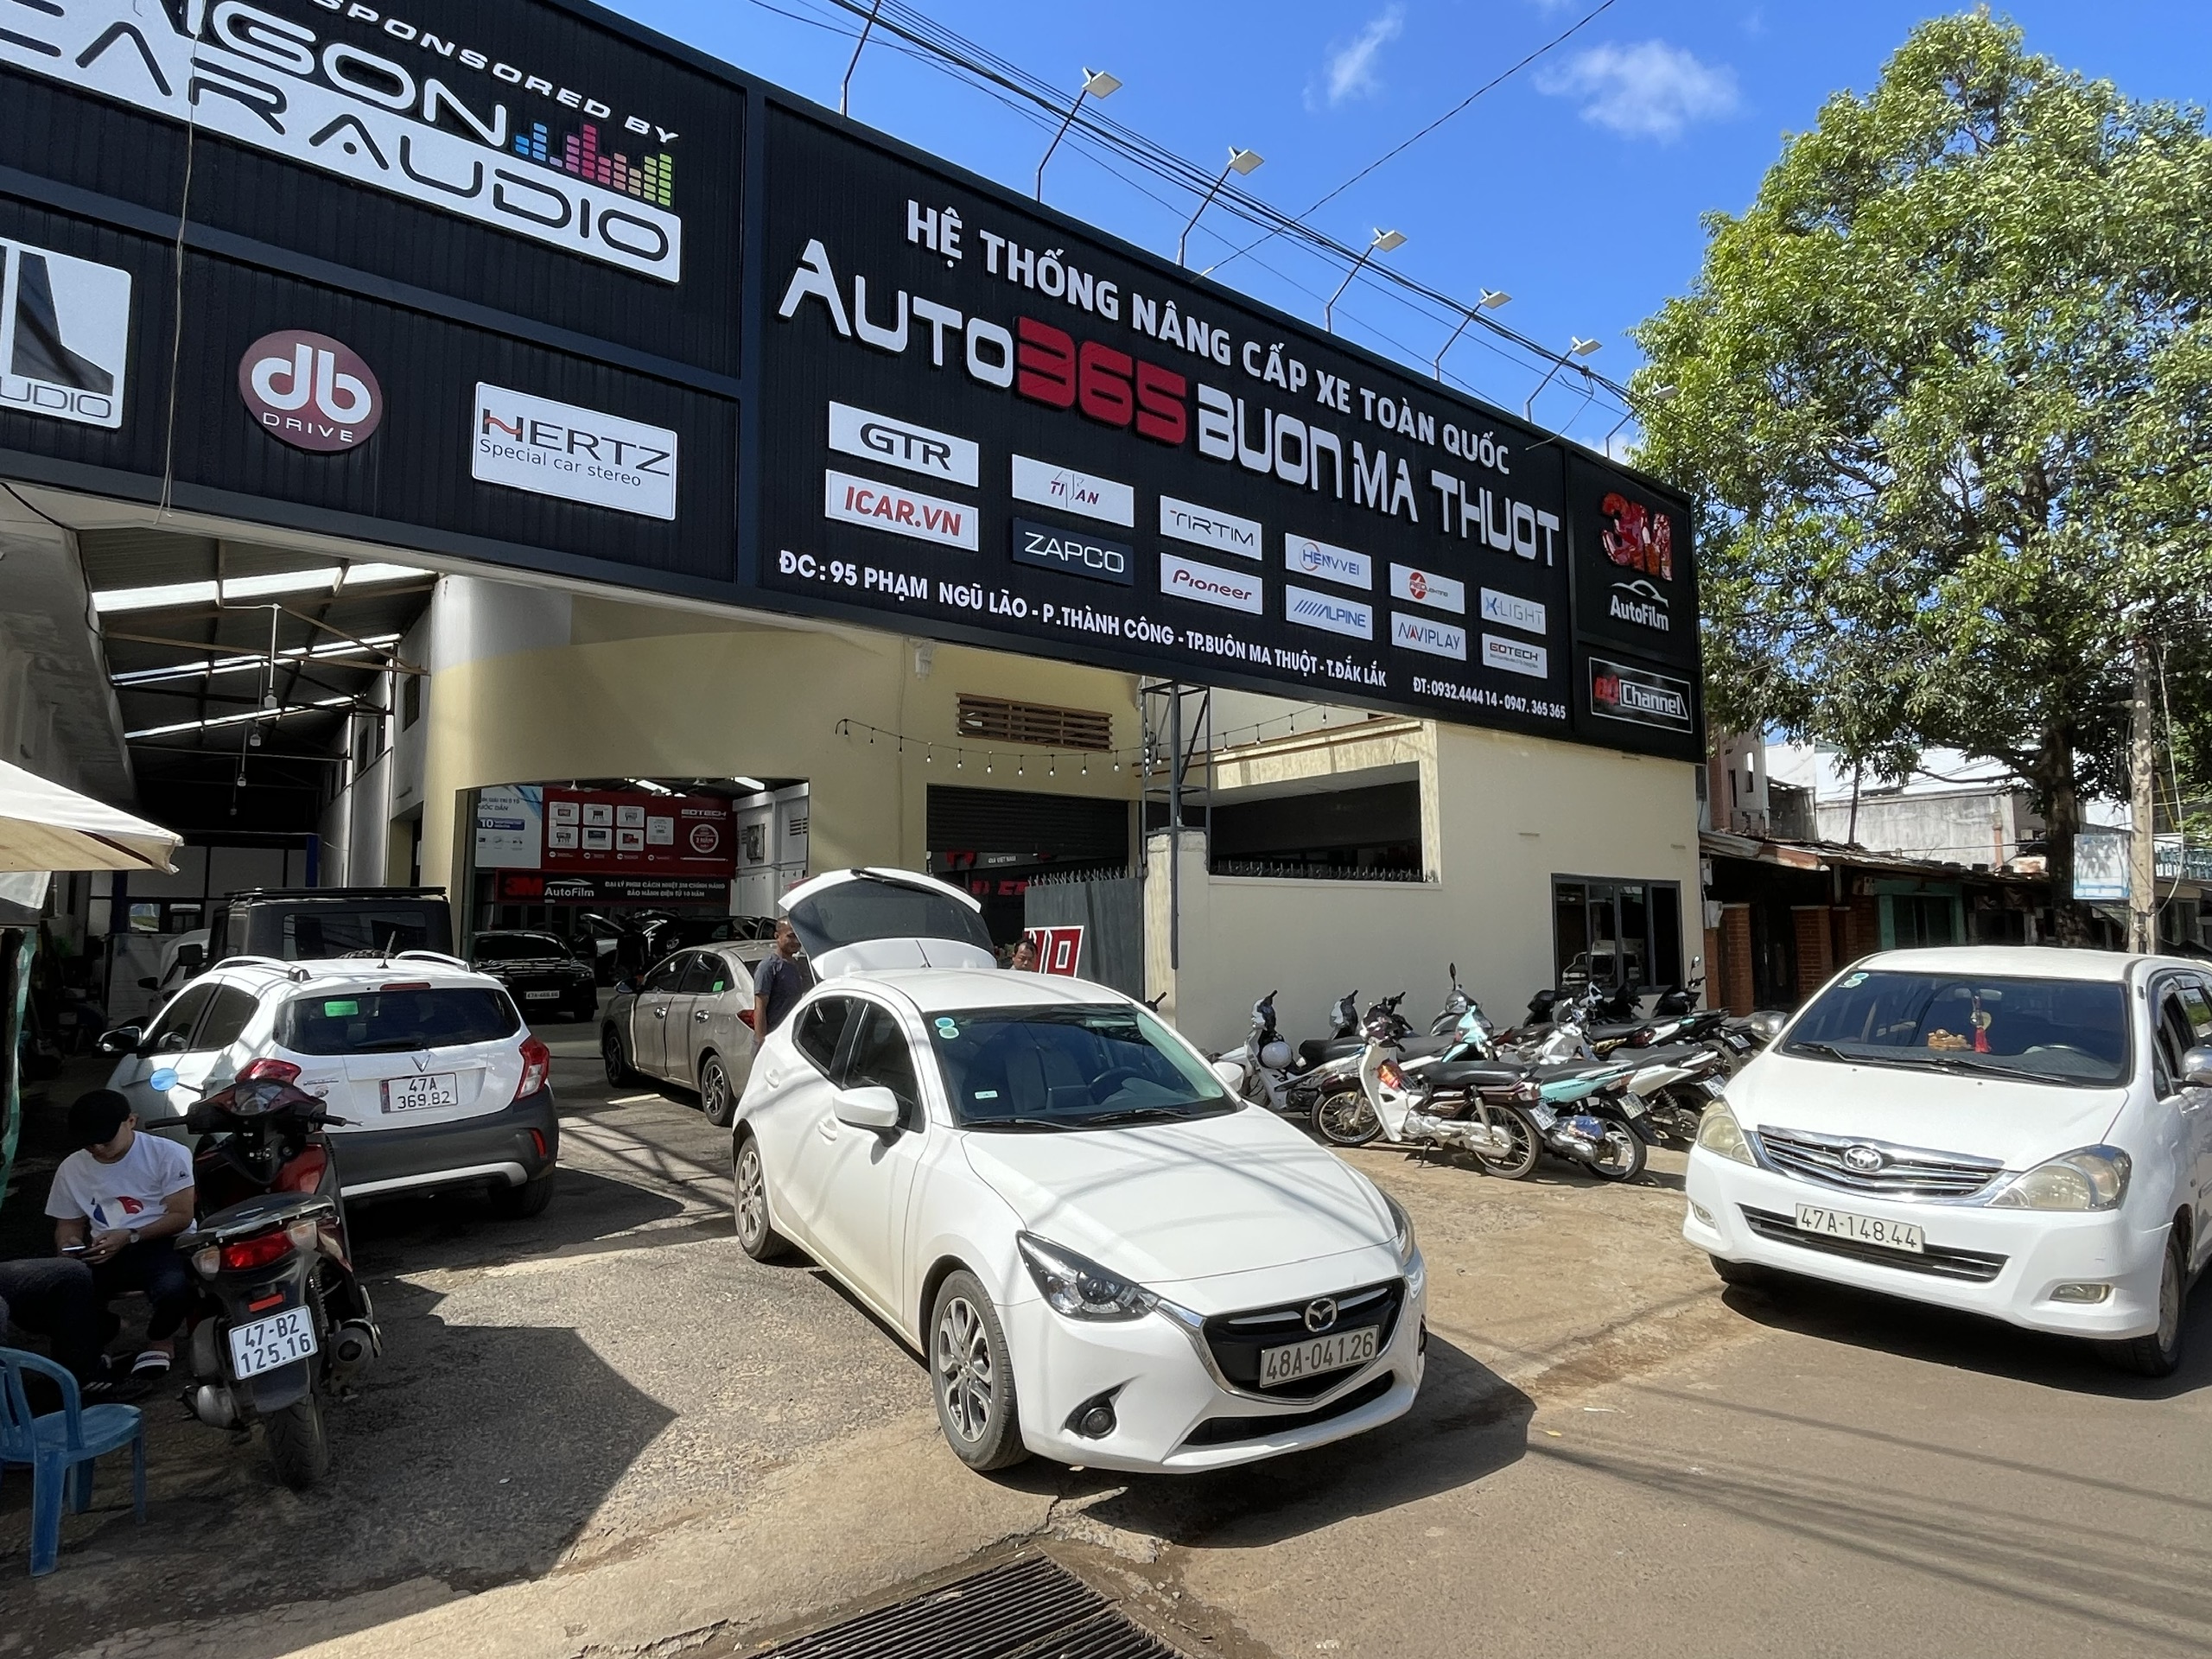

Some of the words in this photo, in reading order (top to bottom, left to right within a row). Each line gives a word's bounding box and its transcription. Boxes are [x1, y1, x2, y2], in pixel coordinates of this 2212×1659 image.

[130, 0, 507, 147] IGON
[624, 116, 679, 144] BY
[907, 199, 963, 268] HỆ
[980, 229, 1119, 321] THỐNG
[1133, 293, 1231, 366] NÂNG
[1243, 342, 1307, 393] CẤP
[1318, 370, 1351, 415] XE
[1360, 387, 1435, 447] TOÀN
[1443, 423, 1510, 475] QUỐC
[251, 343, 372, 424] db
[263, 411, 353, 442] DRIVE
[481, 408, 671, 476] HERTZ
[860, 423, 950, 471] GTR
[480, 438, 547, 467] Special
[554, 459, 582, 474] car
[588, 465, 641, 486] stereo
[845, 486, 961, 537] ICAR.VN
[1353, 442, 1418, 522] MA
[1432, 468, 1559, 567] THUOT
[1170, 510, 1253, 546] TIRTIM
[1602, 492, 1673, 582] 3M
[1025, 531, 1124, 573] ZAPCO
[1173, 569, 1252, 601] Pioneer
[864, 567, 928, 601] PHẠM
[939, 582, 982, 610] NGŨ
[989, 589, 1027, 618] LÃO
[1123, 615, 1174, 645] CÔNG
[1249, 645, 1272, 666] MA
[1274, 649, 1318, 677] THUỘT
[1363, 660, 1387, 688] LẮK
[1316, 604, 1366, 628] ALPINE
[1610, 594, 1669, 632] AutoFilm
[1398, 621, 1460, 651] NAVIPLAY
[1623, 683, 1681, 715] Channel
[505, 877, 543, 896] 3M
[543, 887, 594, 897] AutoFilm
[397, 1090, 450, 1110] 369.82
[409, 1077, 437, 1092] 47A
[1802, 1206, 1918, 1249] 47A-148.44
[244, 1314, 300, 1348] 47-B2
[240, 1332, 312, 1376] 125.16
[1266, 1332, 1374, 1381] 48A-041.26
